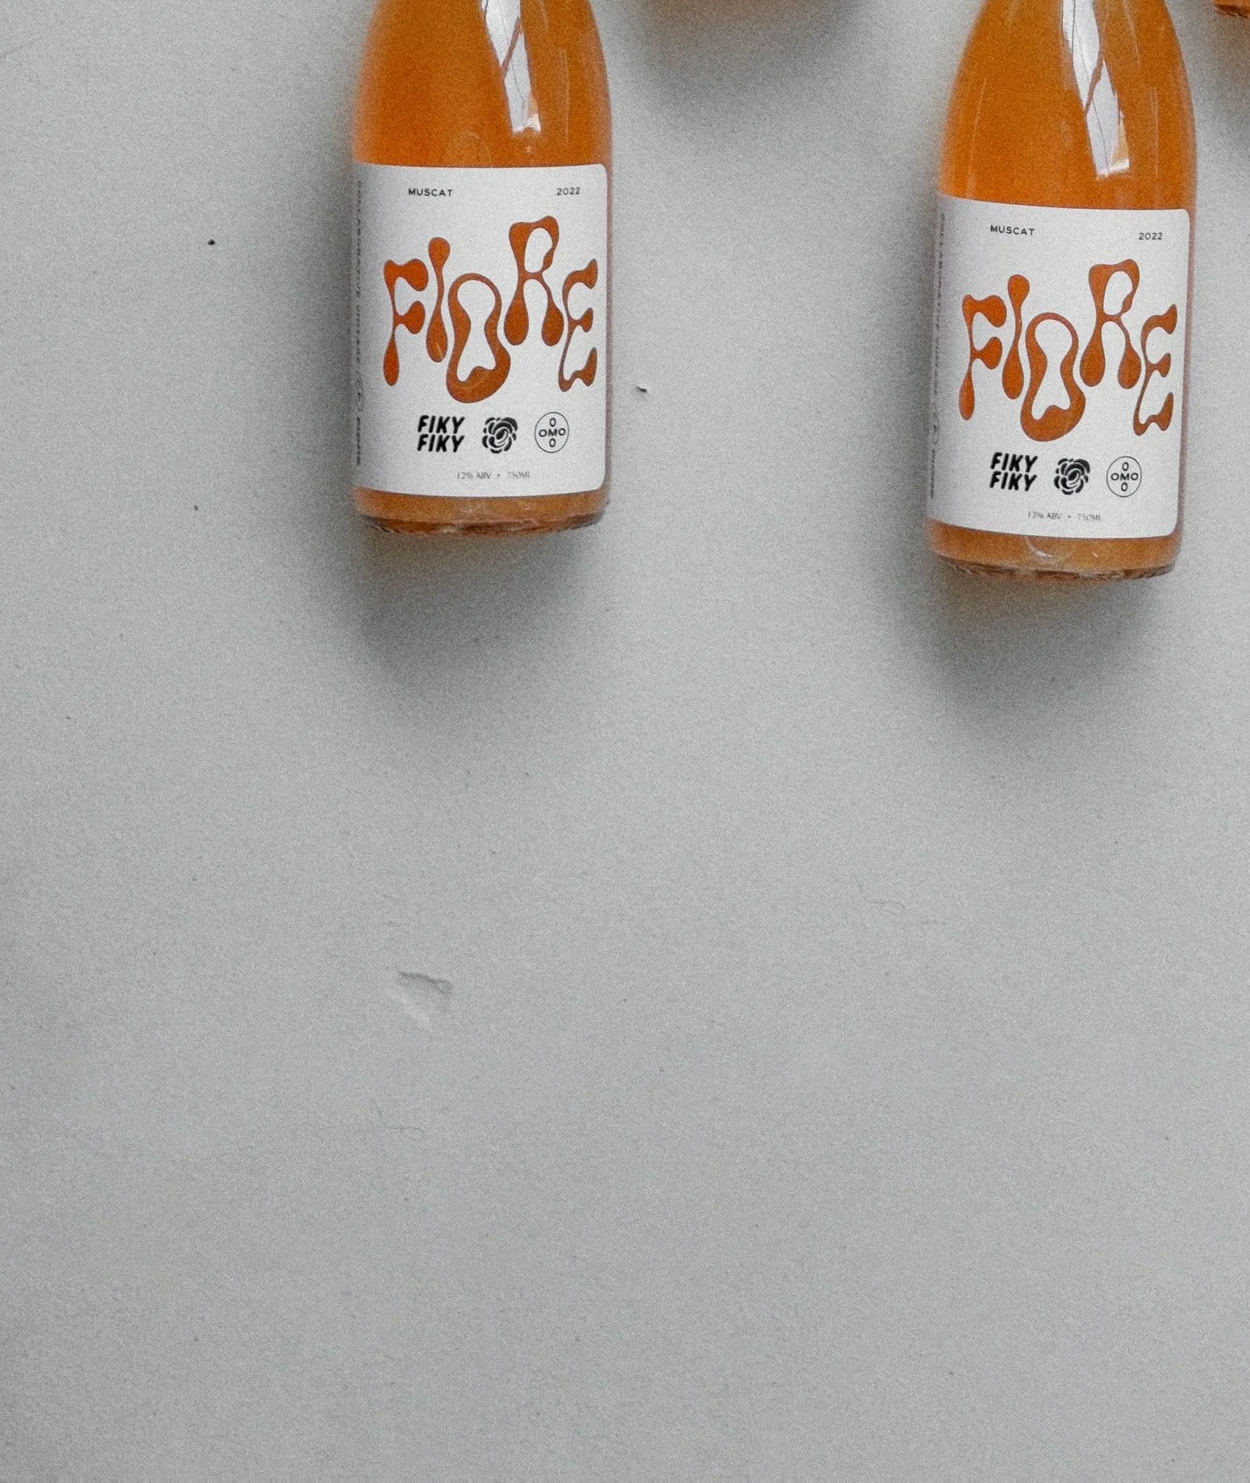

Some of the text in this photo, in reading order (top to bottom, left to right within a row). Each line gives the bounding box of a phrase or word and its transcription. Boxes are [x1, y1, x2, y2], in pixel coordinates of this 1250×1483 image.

[408, 188, 452, 196] MUSCAT
[557, 187, 580, 196] 2022
[990, 225, 1034, 235] MUSCAT
[1139, 232, 1162, 240] 2022
[383, 215, 598, 403] FIORE
[958, 259, 1178, 442] FIORE
[418, 415, 464, 434] FIKY
[418, 434, 464, 452] FIKY
[991, 452, 1037, 472] FIKY
[990, 471, 1036, 491] FIKY
